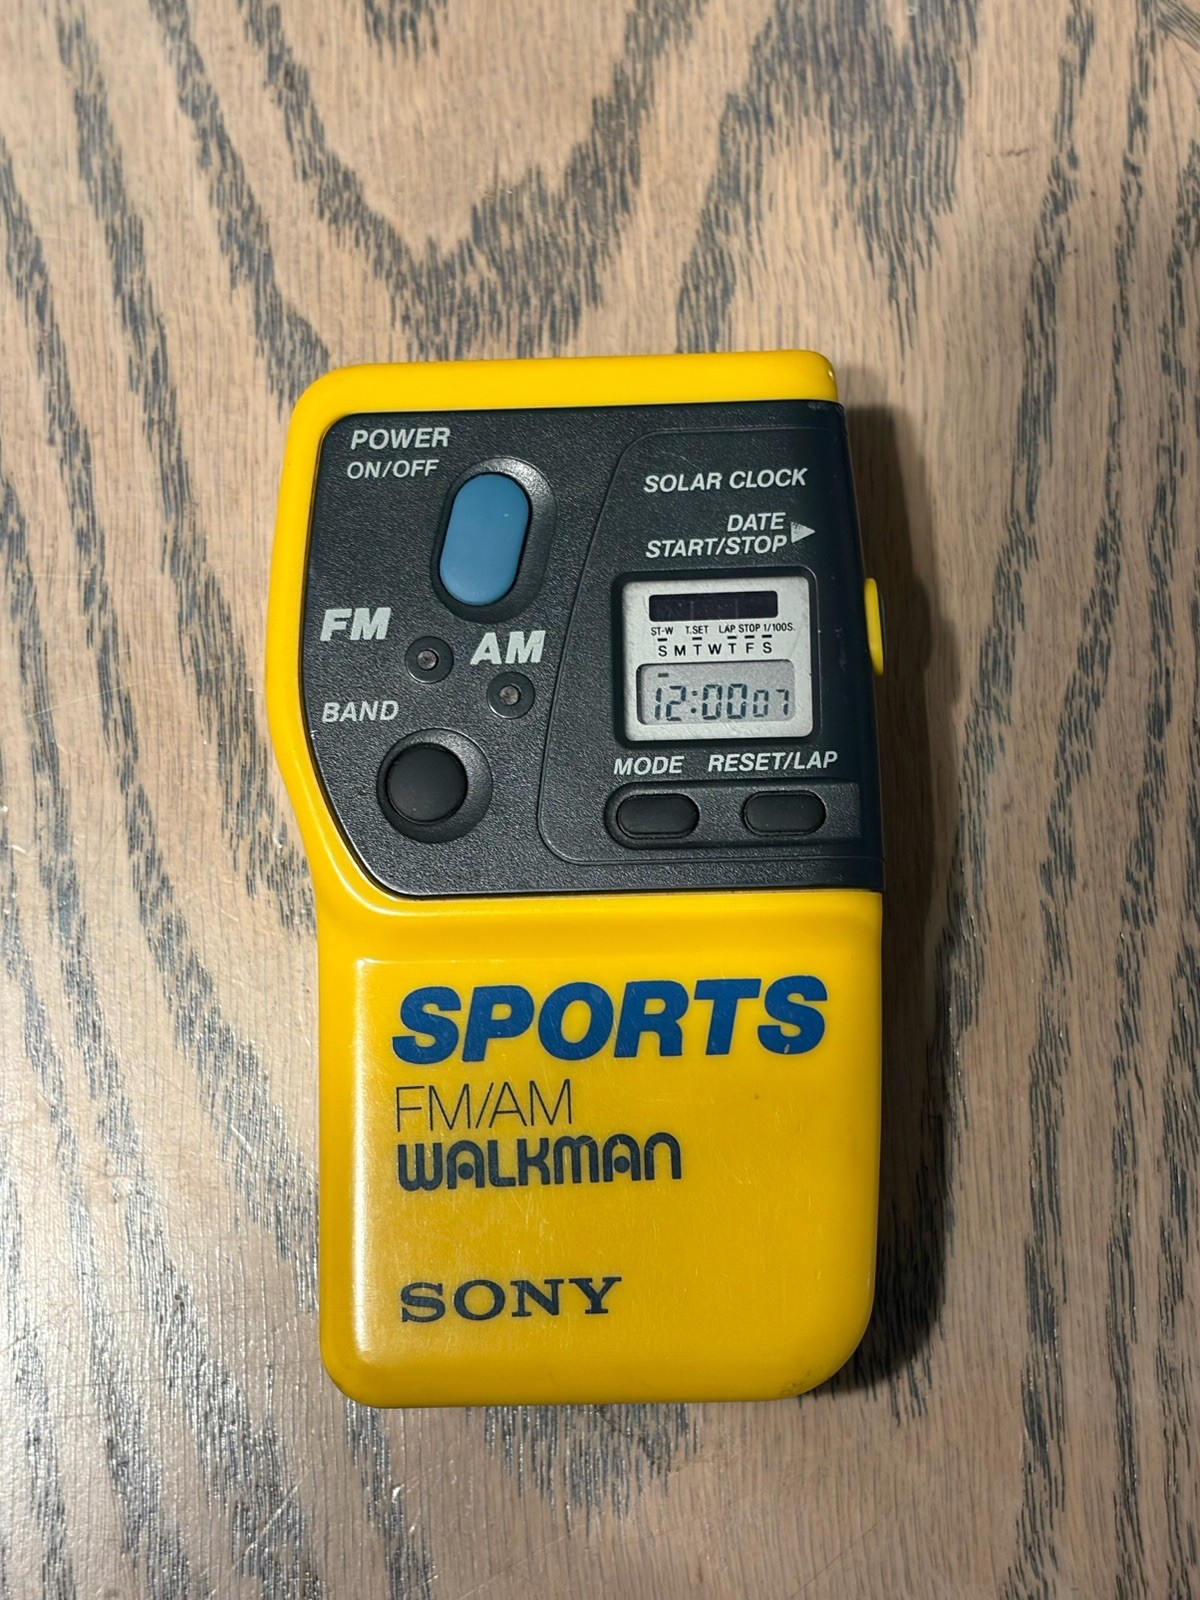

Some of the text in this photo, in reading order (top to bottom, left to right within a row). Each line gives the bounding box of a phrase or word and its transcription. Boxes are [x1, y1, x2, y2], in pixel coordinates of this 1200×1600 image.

[350, 427, 451, 450] POWER
[347, 459, 439, 480] ON/OFF
[643, 467, 808, 493] SOLAR CLOCK
[727, 512, 786, 532] DATE
[645, 534, 788, 558] START/STOP
[320, 607, 392, 642] FM
[651, 626, 674, 636] ST-W
[685, 625, 709, 635] T.SET
[718, 624, 736, 634] LAP
[738, 623, 761, 633] STOP
[470, 630, 546, 665] AM
[658, 641, 772, 657] S M T W T F S
[322, 700, 399, 723] BAND
[613, 755, 685, 775] MODE
[708, 750, 838, 772] RESET/LAP
[392, 975, 828, 1065] SPORTS
[396, 1079, 573, 1132] FM/AM
[397, 1132, 682, 1192] WALKMAN
[401, 1277, 622, 1323] SONY
